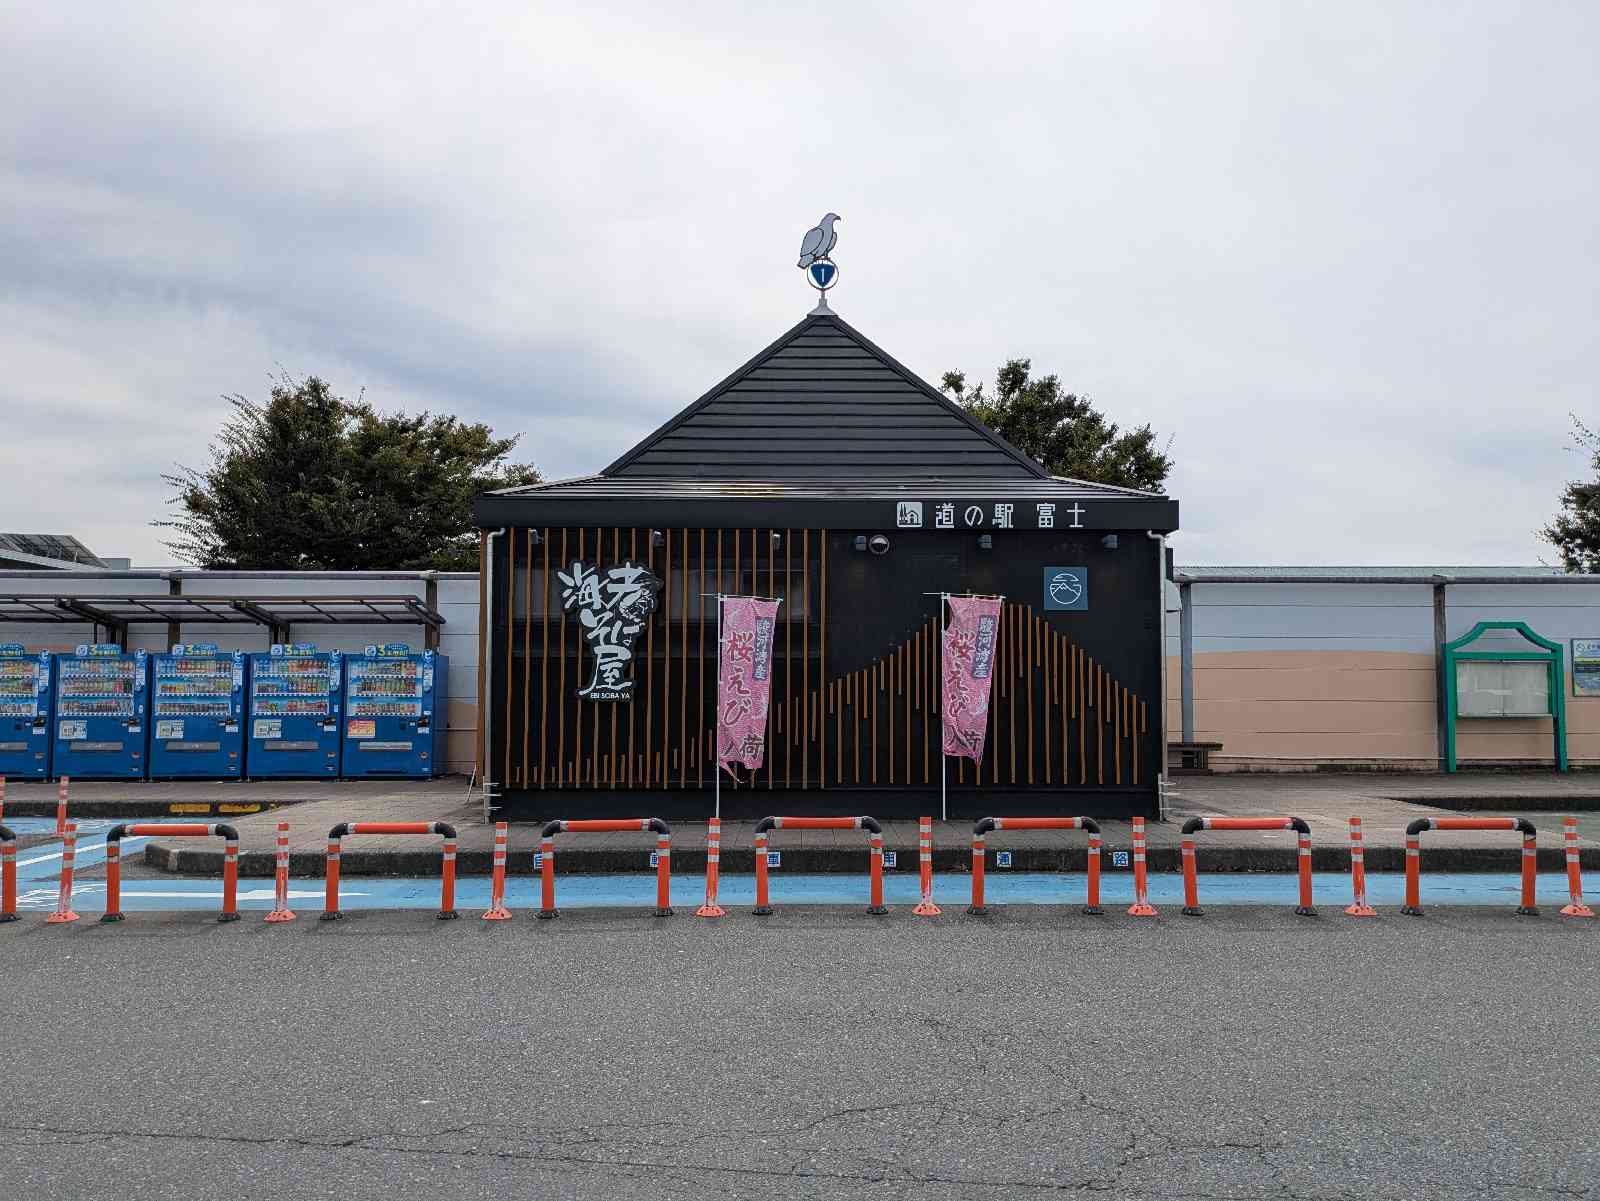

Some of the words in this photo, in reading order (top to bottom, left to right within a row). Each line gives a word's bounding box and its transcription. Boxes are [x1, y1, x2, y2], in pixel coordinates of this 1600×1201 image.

[935, 502, 1014, 529] 道の駅
[1036, 502, 1086, 529] 富士
